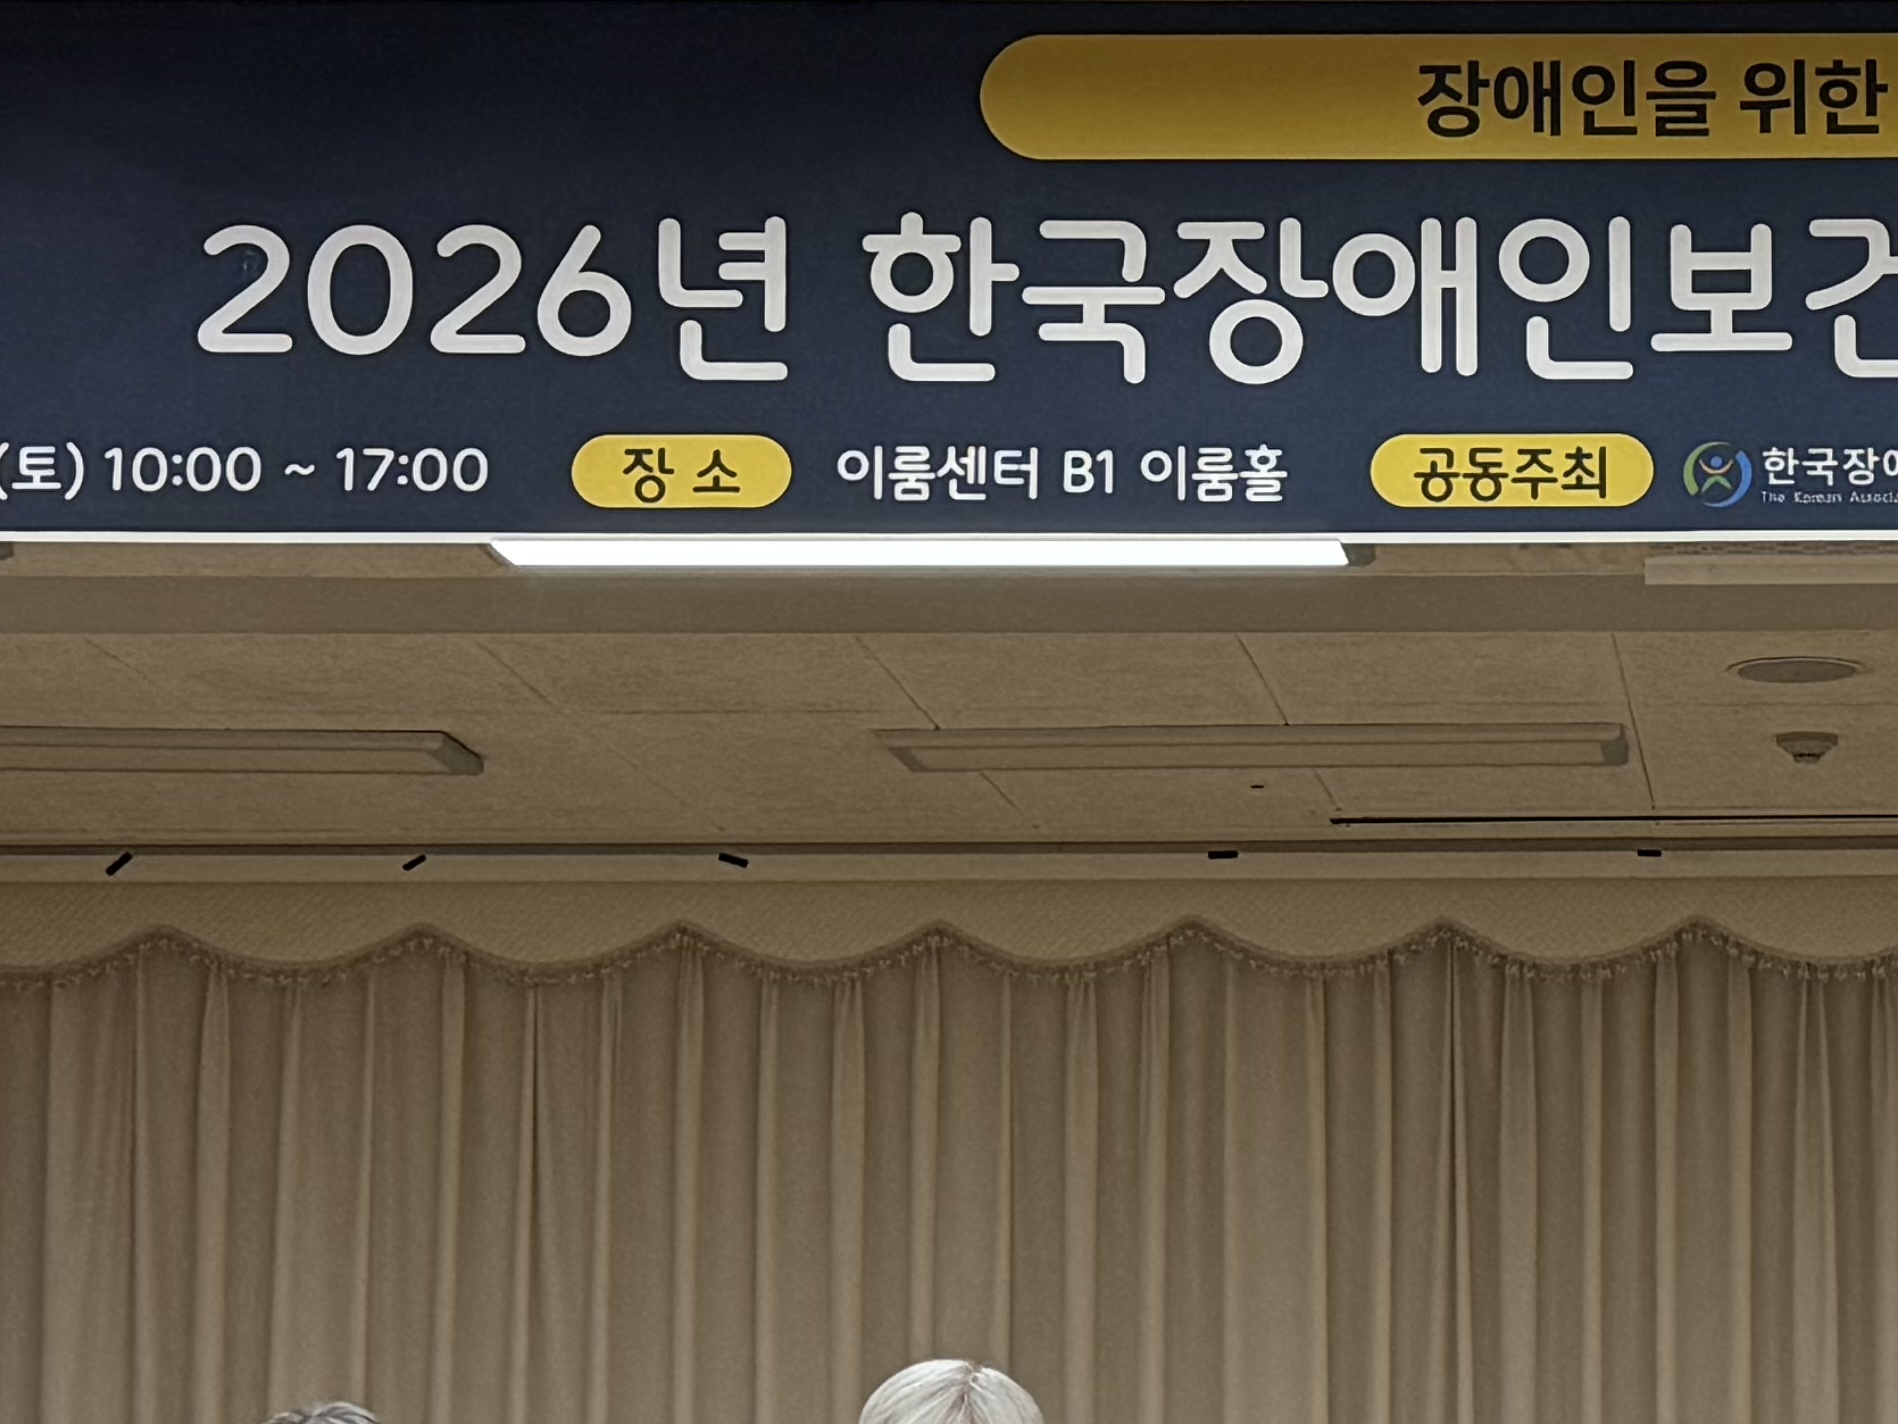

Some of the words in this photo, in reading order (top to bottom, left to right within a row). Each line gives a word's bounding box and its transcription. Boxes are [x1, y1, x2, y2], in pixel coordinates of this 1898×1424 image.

[1417, 59, 1717, 138] 장애인을
[1739, 58, 1889, 135] 위한
[197, 216, 789, 381] 2026년
[104, 446, 262, 492] 10:00
[336, 447, 488, 492] 17:00
[837, 445, 1039, 501] 이룸센터
[1063, 449, 1114, 494] B1
[1140, 443, 1288, 502] 이룸홀
[1413, 446, 1609, 503] 공동주최
